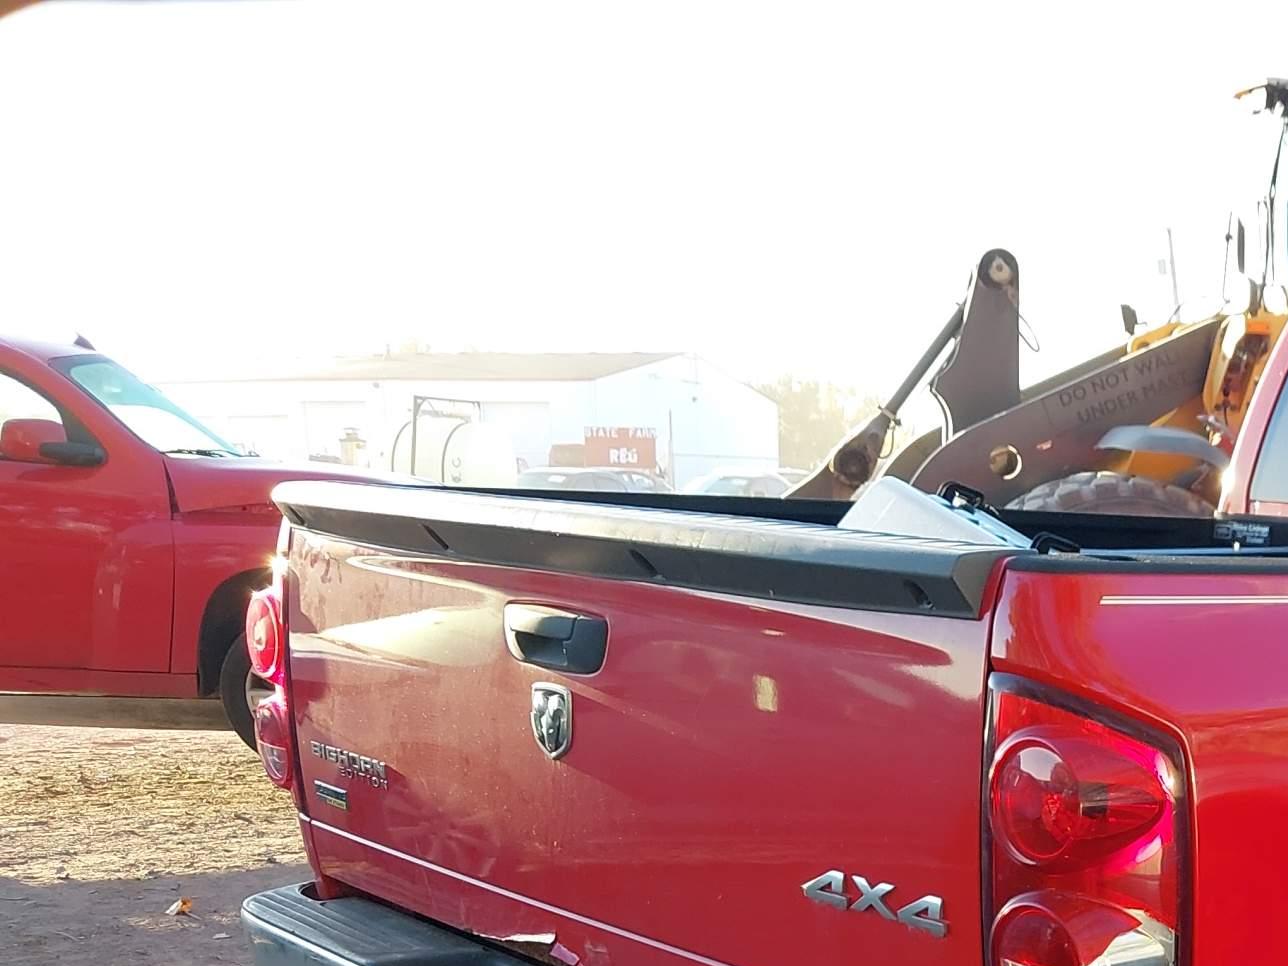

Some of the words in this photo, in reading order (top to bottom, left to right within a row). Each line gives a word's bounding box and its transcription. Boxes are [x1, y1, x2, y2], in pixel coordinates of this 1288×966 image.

[1059, 387, 1087, 408] DO
[1091, 368, 1129, 397] NOT
[1076, 390, 1137, 424] UNDER
[584, 425, 618, 438] STATE
